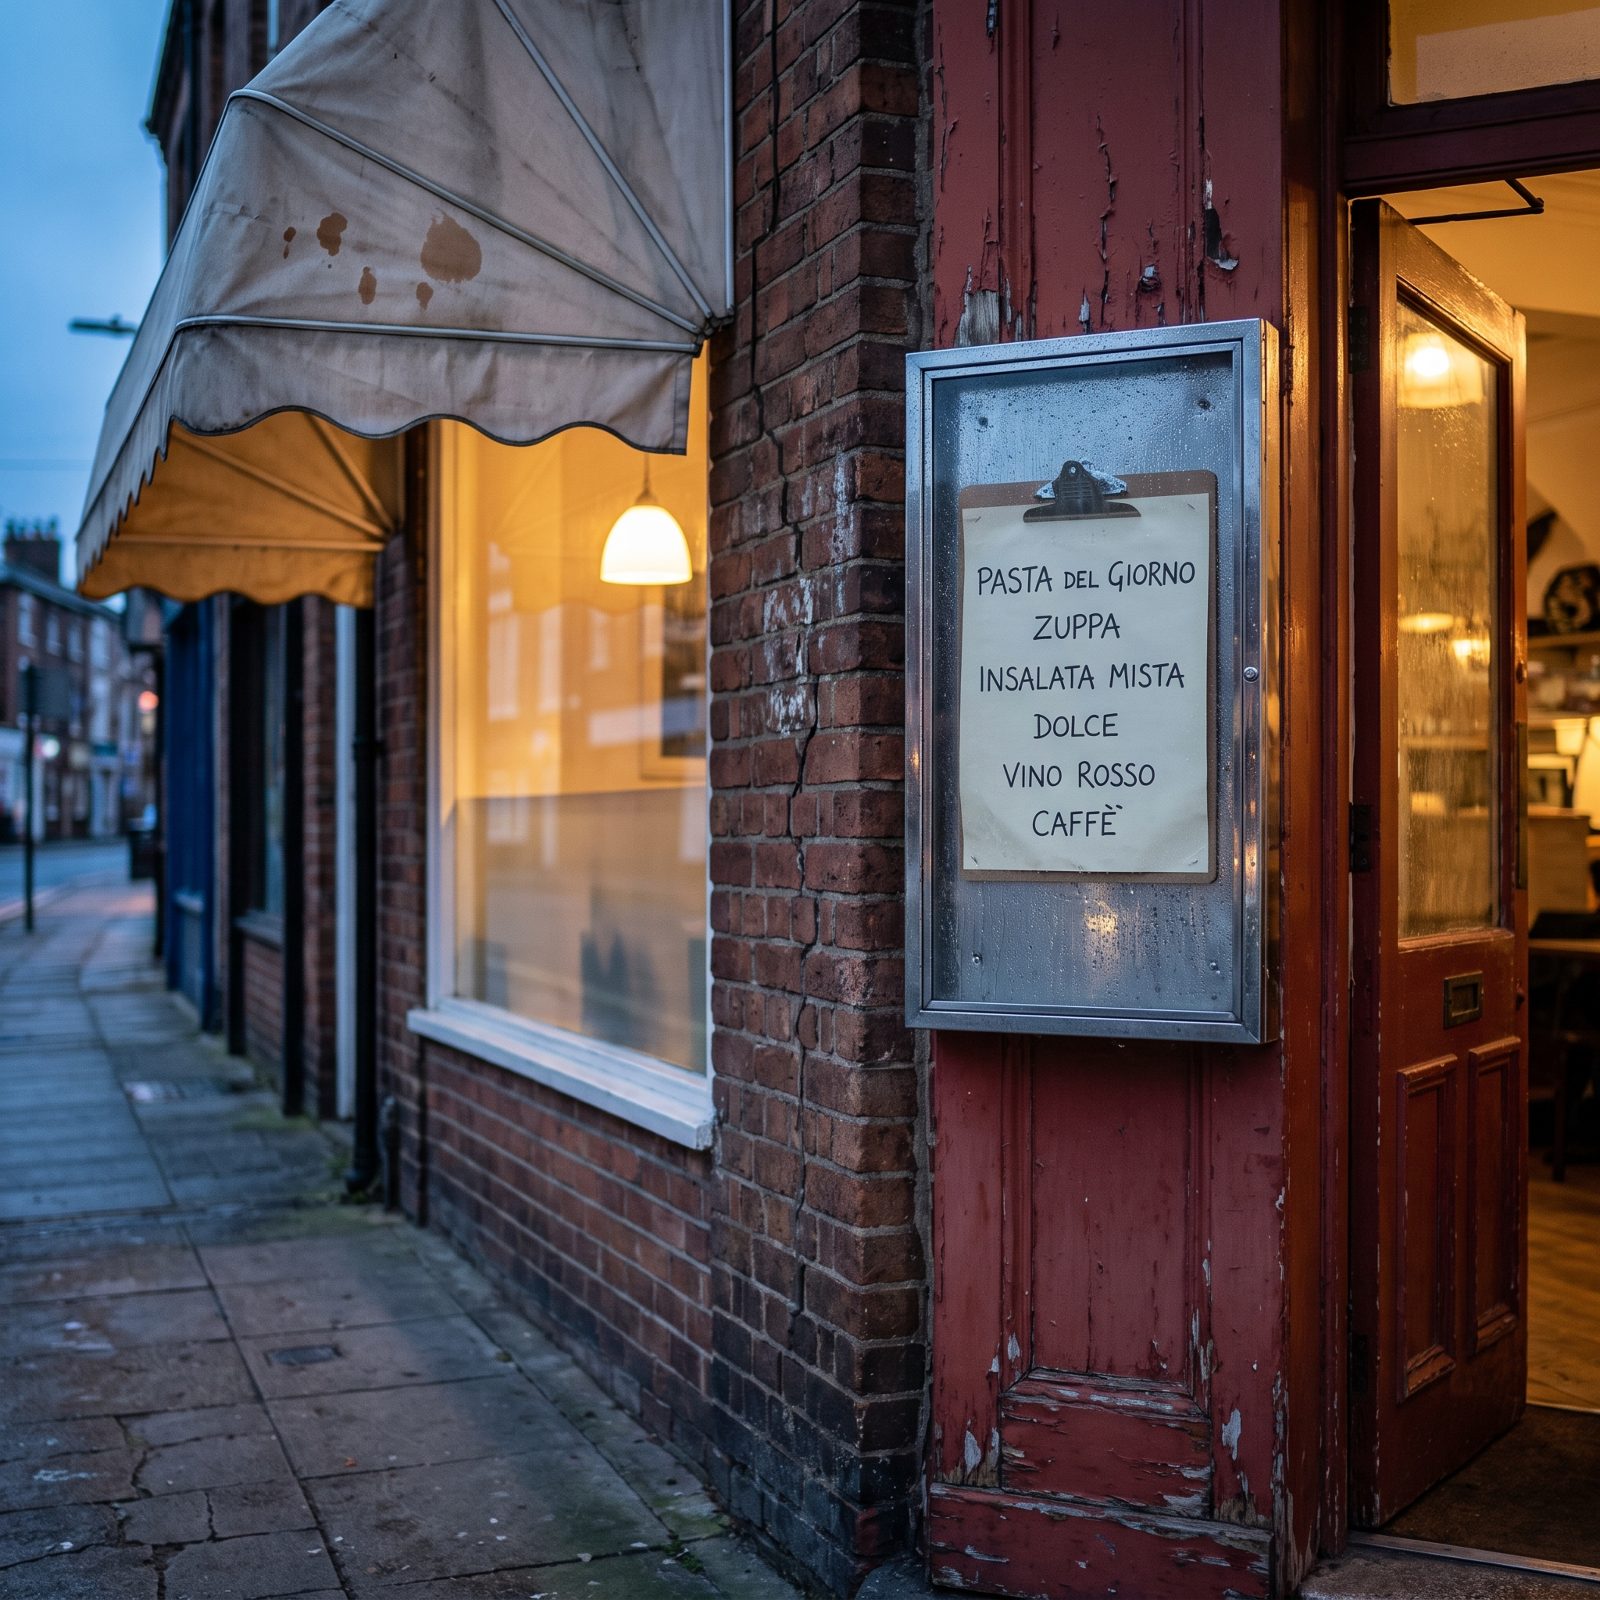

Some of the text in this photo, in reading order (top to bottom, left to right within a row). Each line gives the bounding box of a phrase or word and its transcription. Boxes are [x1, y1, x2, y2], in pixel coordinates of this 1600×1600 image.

[977, 560, 1196, 596] PASTA DEL GIORNO
[1032, 612, 1121, 641] ZUPPA
[980, 662, 1185, 693] INSALATA MISTA
[1033, 712, 1119, 740] DOLCE
[1002, 760, 1156, 789] VINO ROSSO
